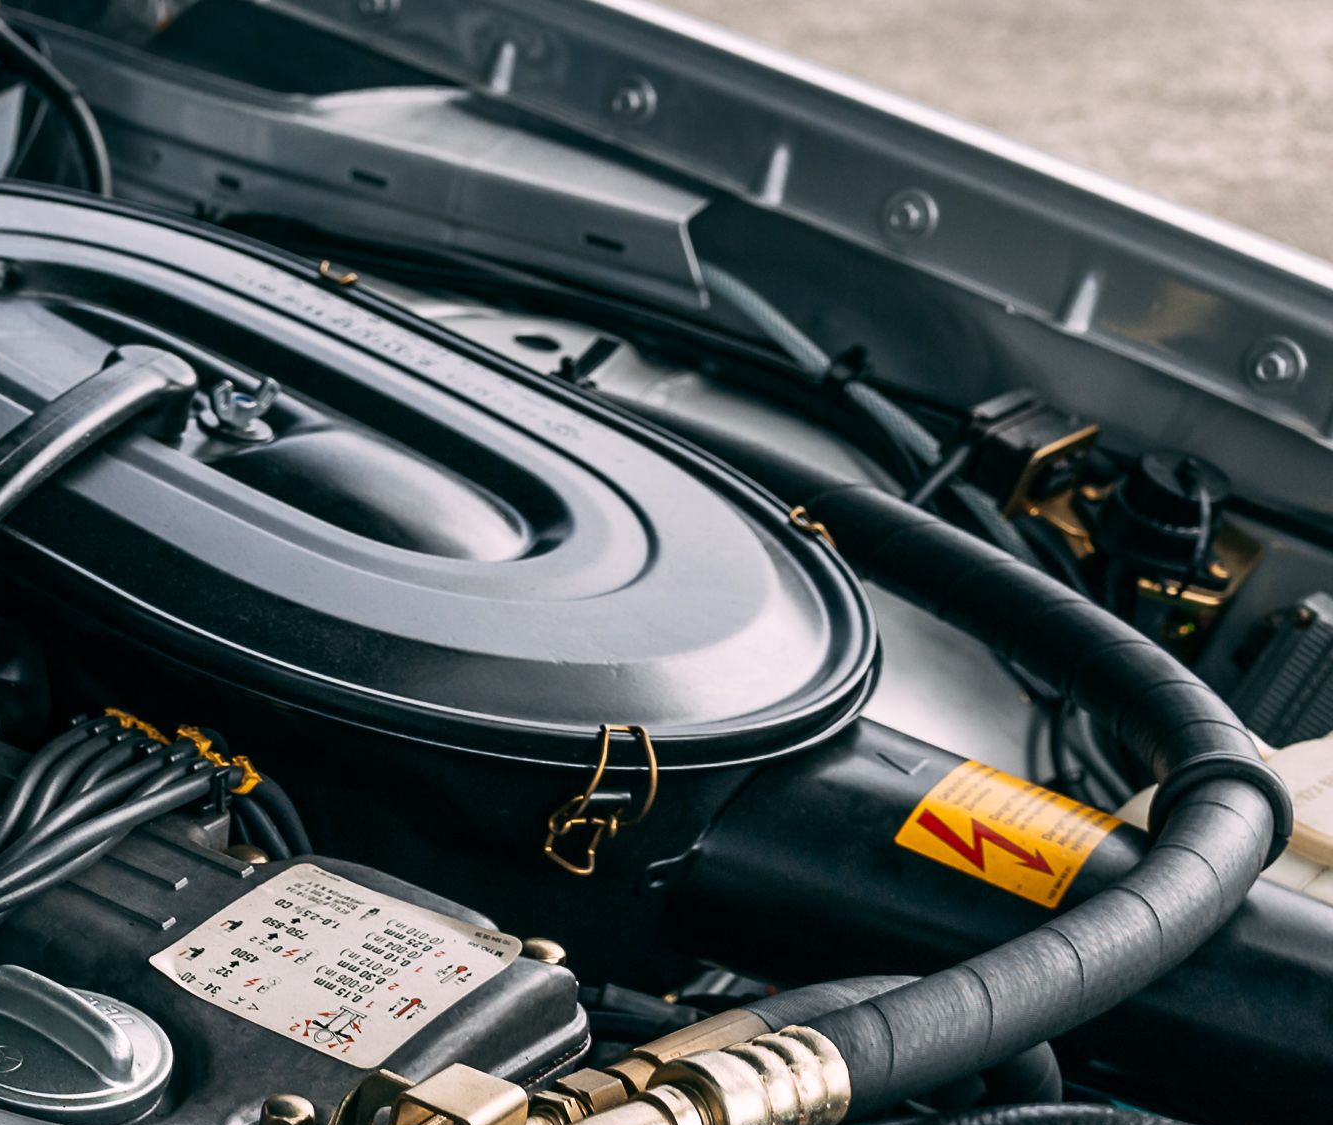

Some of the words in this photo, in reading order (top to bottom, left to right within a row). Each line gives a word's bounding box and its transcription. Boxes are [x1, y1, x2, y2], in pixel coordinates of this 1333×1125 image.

[274, 898, 293, 909] CO
[262, 917, 308, 940] 750-850
[386, 919, 408, 930] in.)
[365, 932, 387, 943] in.)
[383, 928, 407, 940] mm
[361, 942, 385, 955] mm
[406, 938, 433, 952] 0,25
[231, 947, 259, 963] 4500
[339, 948, 361, 960] in.)
[383, 952, 411, 967] 0,10
[434, 950, 446, 958] 2
[208, 966, 233, 978] 32°
[315, 965, 337, 979] in.)
[337, 960, 360, 973] mm
[359, 970, 387, 985] 0,30
[313, 977, 337, 991] mm
[387, 982, 400, 991] 2
[335, 987, 363, 1003] 0,15
[365, 1000, 374, 1008] 1
[289, 1022, 301, 1032] 2
